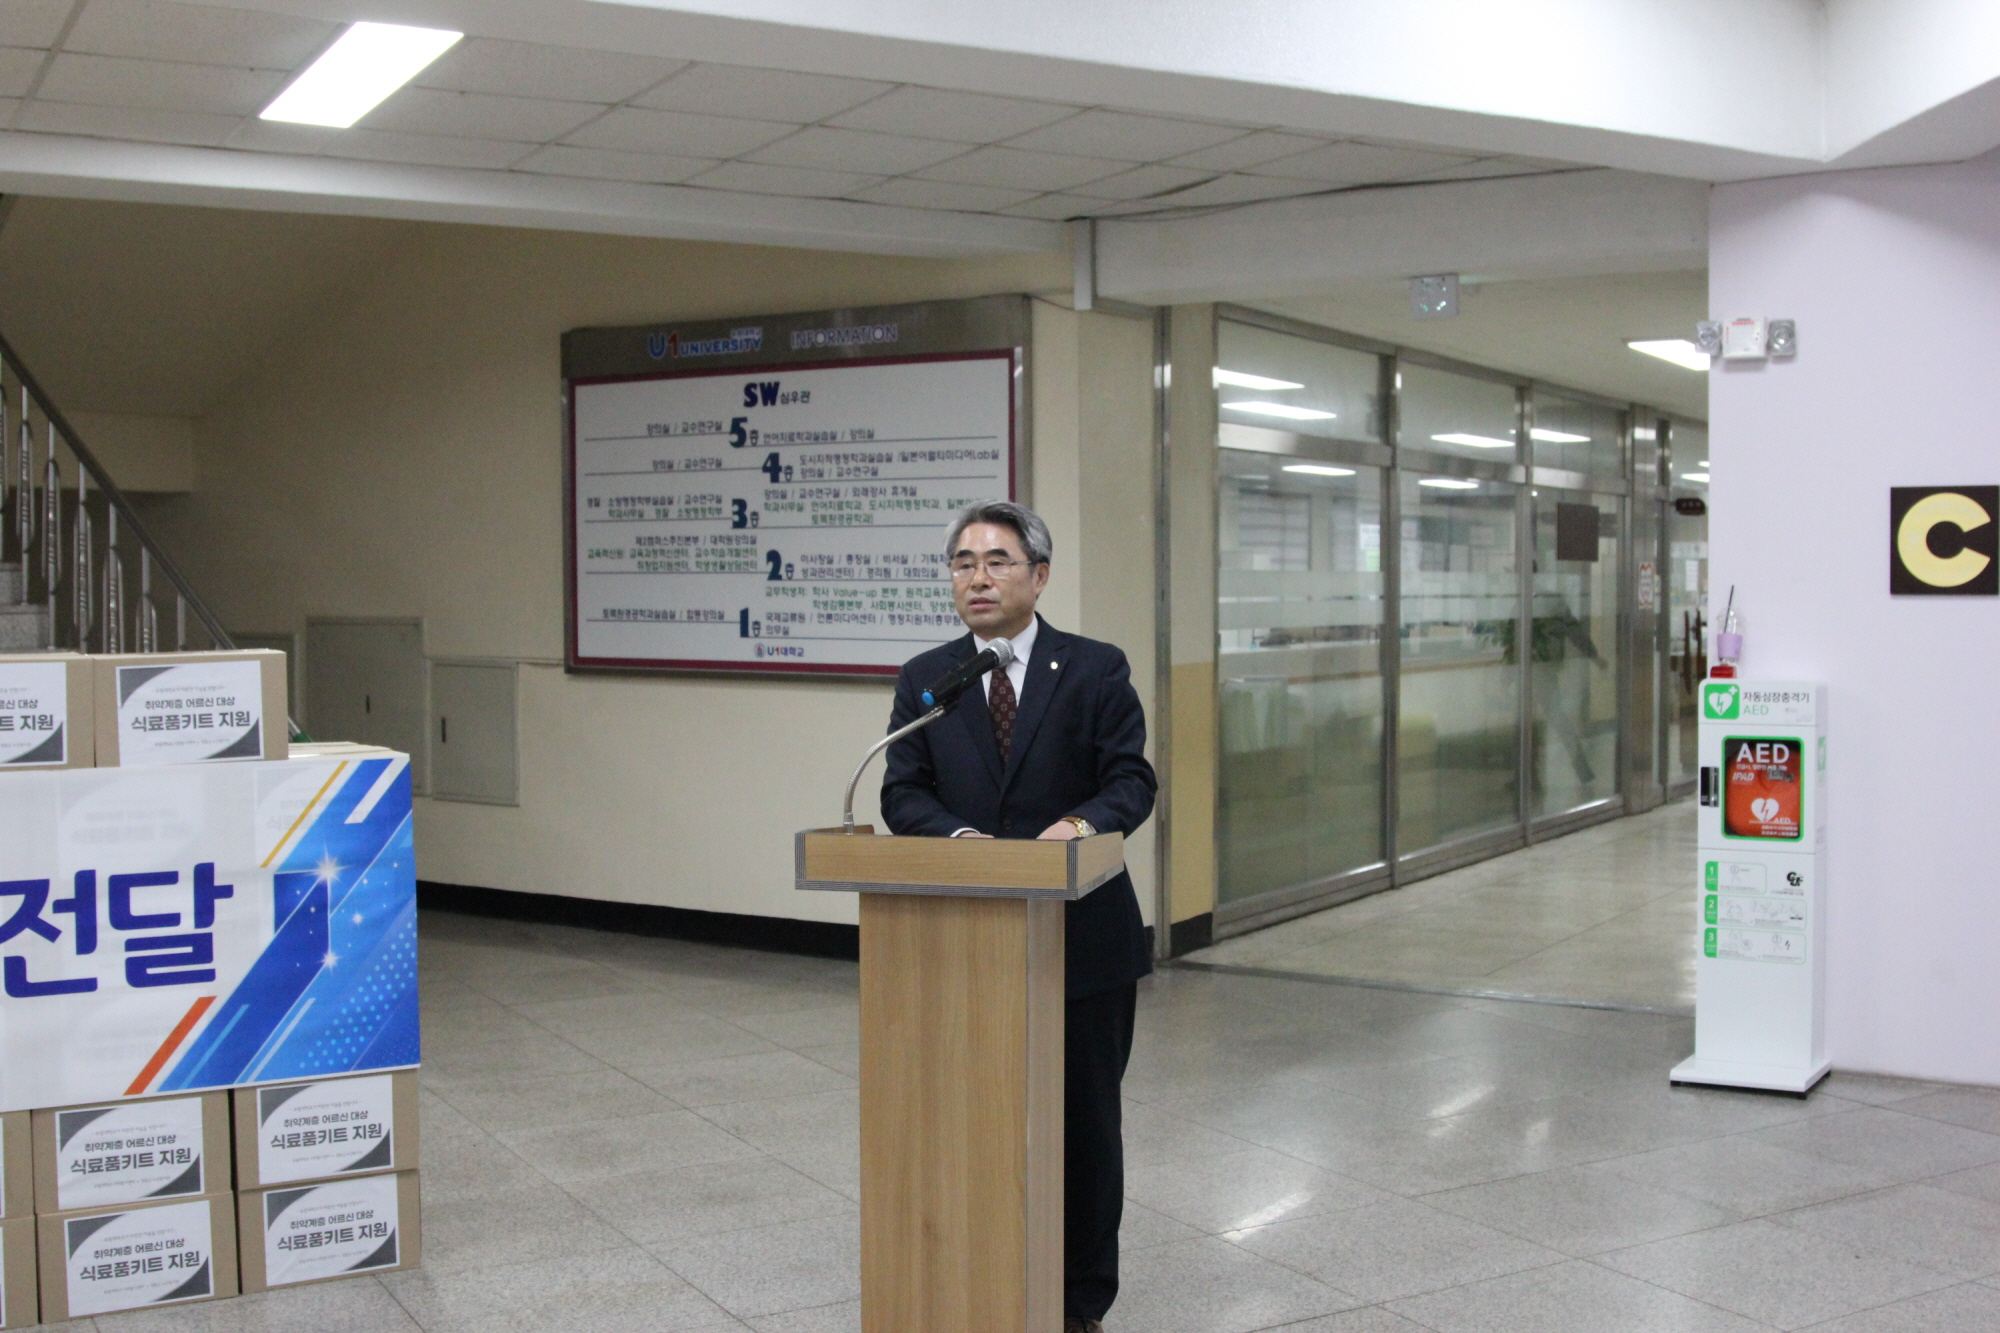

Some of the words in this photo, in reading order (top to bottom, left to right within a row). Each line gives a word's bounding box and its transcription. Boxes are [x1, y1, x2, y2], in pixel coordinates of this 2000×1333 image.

[790, 324, 898, 349] INFORMATION
[680, 338, 762, 357] UNIVERSITY
[682, 420, 723, 433] 교수연구실
[850, 428, 875, 440] 강의실
[684, 457, 723, 469] 교수연구실
[800, 467, 824, 479] 강의실
[836, 466, 879, 477] 교수연구실
[764, 488, 788, 500] 강의실
[799, 487, 841, 499] 교수연구실
[852, 486, 887, 498] 외래강사
[891, 485, 918, 497] 휴게실
[1898, 492, 1991, 588] C
[801, 553, 834, 566] 이사장실
[846, 553, 871, 565] 총장실
[883, 553, 909, 565] 비서실
[867, 566, 891, 579] 경리팀
[903, 566, 939, 579] 대회의실
[812, 586, 830, 598] 학사
[833, 587, 877, 599] Value-up
[765, 612, 806, 624] 국제교류원
[816, 612, 876, 625] 언론미디어센터
[765, 625, 790, 637] 의무실
[18, 698, 38, 710] 대상
[145, 698, 183, 710] 취약계층
[186, 697, 215, 709] 어르신
[216, 696, 236, 707] 대상
[1743, 691, 1810, 704] 자동심장충격기
[1743, 704, 1769, 715] AED
[20, 714, 54, 731] 지원
[131, 712, 214, 732] 식료품키트
[219, 711, 251, 728] 지원
[1736, 743, 1790, 764] AED
[1709, 866, 1715, 875] 1
[1708, 900, 1715, 909] 2
[0, 862, 234, 998] 전달
[1708, 932, 1715, 942] 3
[284, 1115, 320, 1128] 취약계층
[322, 1112, 349, 1124] 어르신
[350, 1110, 369, 1121] 대상
[84, 1138, 124, 1153] 취약계층
[126, 1135, 155, 1149] 어르신
[157, 1134, 177, 1145] 대상
[270, 1127, 349, 1150] 식료품키트
[352, 1123, 382, 1140] 지원
[70, 1152, 154, 1176] 식료품키트
[159, 1147, 191, 1166] 지원
[290, 1216, 326, 1230] 취약계층
[328, 1213, 355, 1225] 어르신
[356, 1209, 375, 1220] 대상
[277, 1228, 354, 1252] 식료품키트
[358, 1221, 388, 1240] 지원
[93, 1245, 132, 1260] 취약계층
[134, 1242, 164, 1255] 어르신
[165, 1238, 185, 1249] 대상
[79, 1256, 164, 1282] 식료품키트
[168, 1250, 200, 1270] 지원
